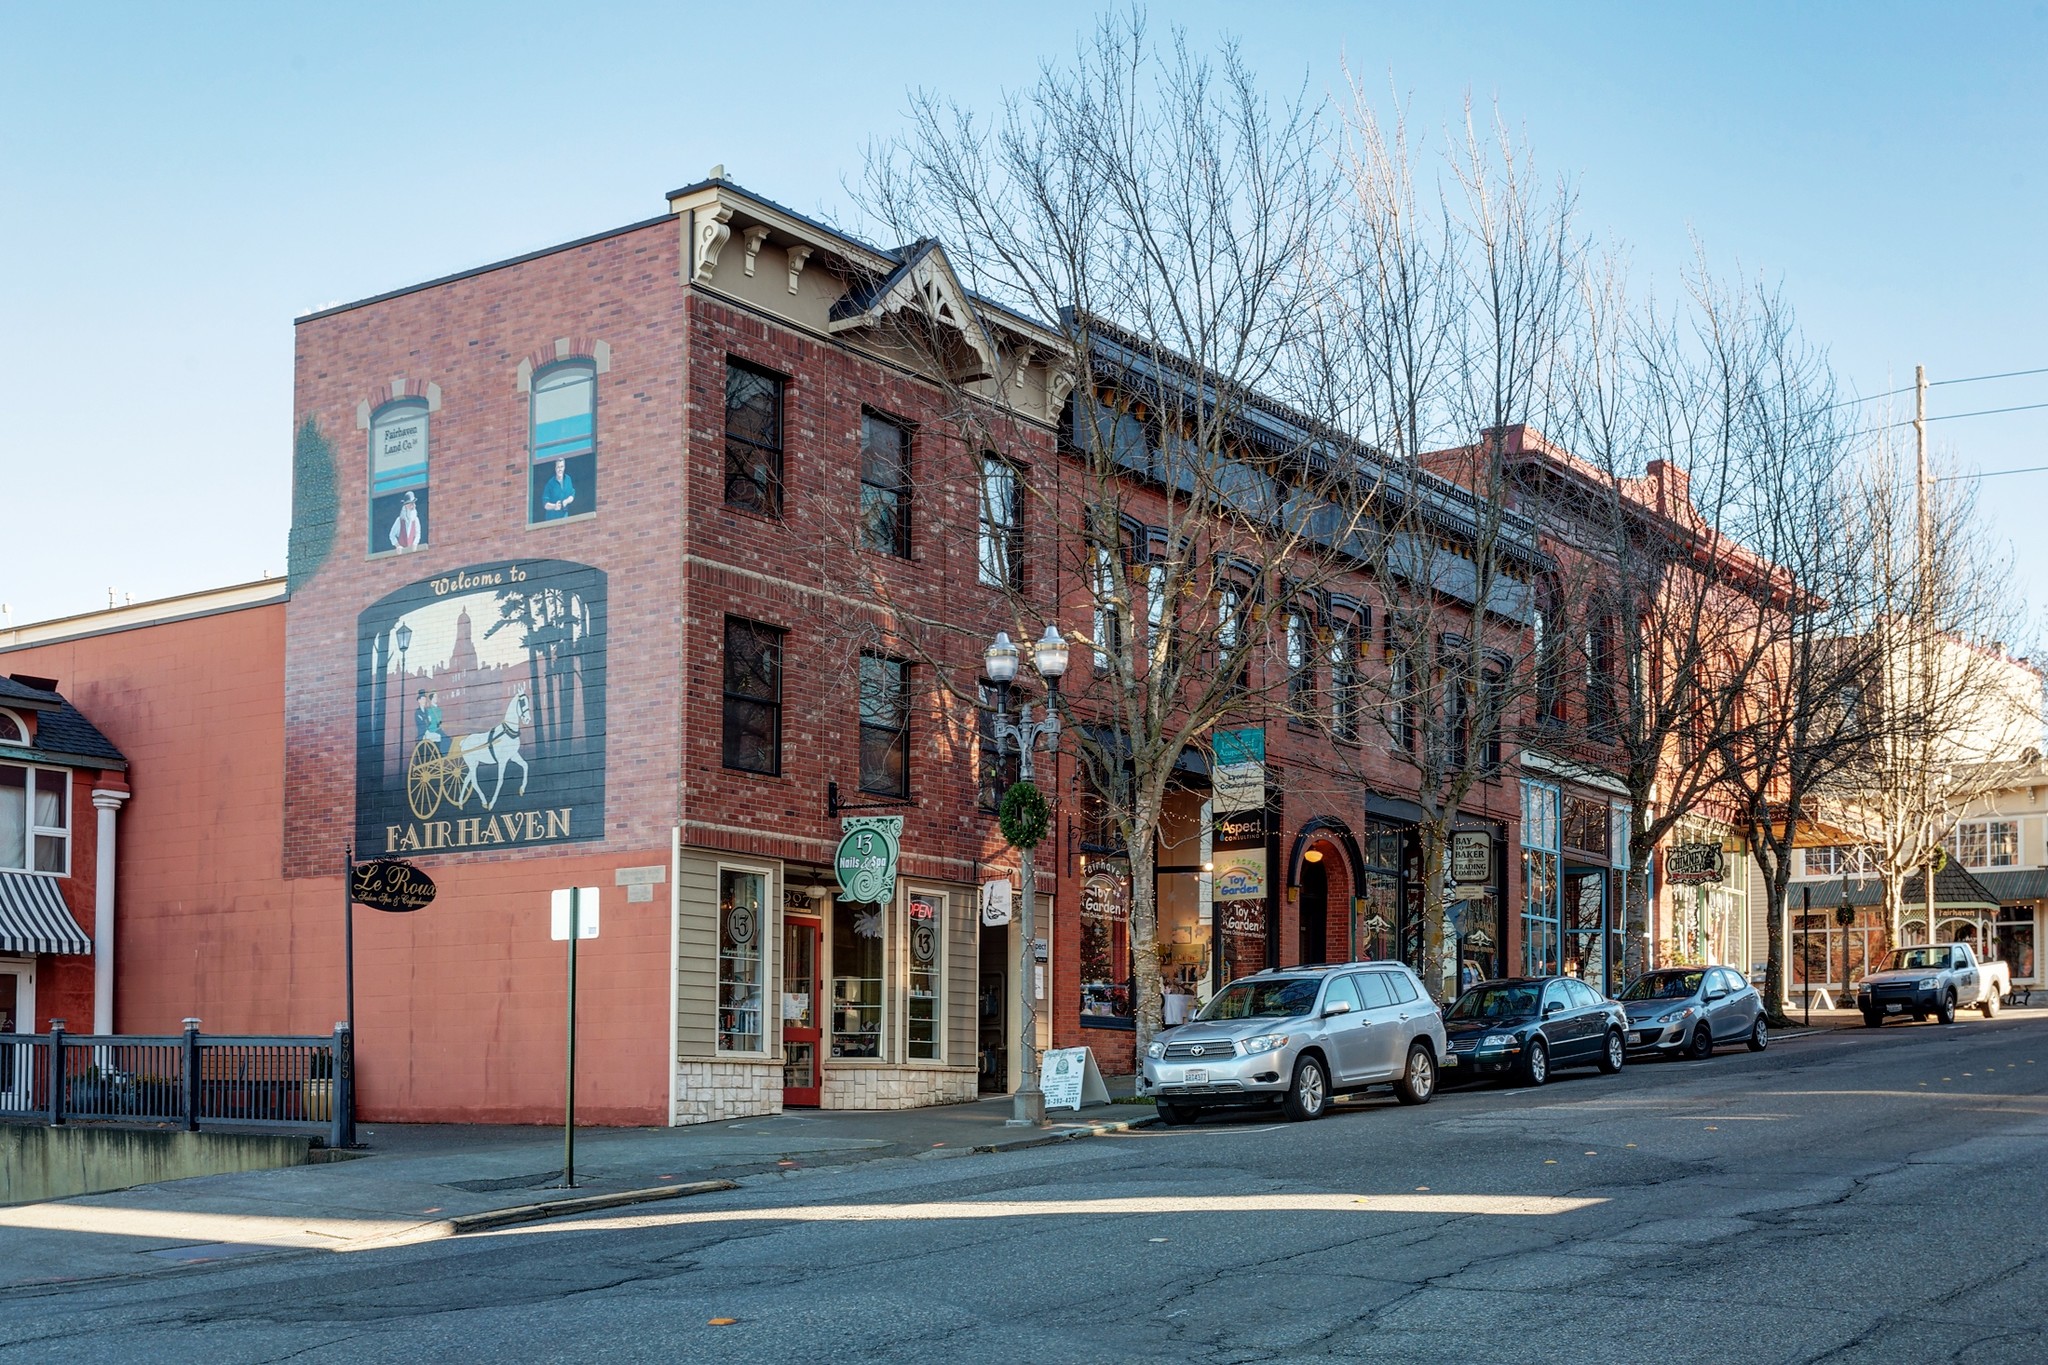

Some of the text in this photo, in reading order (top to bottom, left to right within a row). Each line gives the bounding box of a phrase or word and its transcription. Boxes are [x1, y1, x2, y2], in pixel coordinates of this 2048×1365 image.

[385, 427, 418, 440] Fairhaven
[385, 441, 401, 454] Land
[430, 565, 526, 596] Welcome to
[385, 808, 573, 853] FAIRHAVEN
[1222, 819, 1262, 837] Aspect
[856, 834, 873, 856] 13
[1224, 834, 1260, 842] CONSULTING
[1455, 837, 1472, 845] BAY
[840, 857, 860, 869] Nails
[871, 856, 887, 869] Spa
[1455, 850, 1484, 858] BAKER
[1670, 851, 1706, 871] CHIMNEY
[353, 863, 382, 892] Le
[1083, 858, 1125, 882] Fairhaven
[1221, 884, 1259, 896] Garden
[1228, 875, 1246, 888] Toy
[1092, 884, 1109, 902] Toy
[1085, 897, 1121, 915] Garden
[1234, 904, 1248, 920] Toy
[733, 913, 749, 937] 13
[1228, 916, 1259, 931] Garden
[917, 933, 931, 954] 13
[342, 1034, 350, 1078] 905
